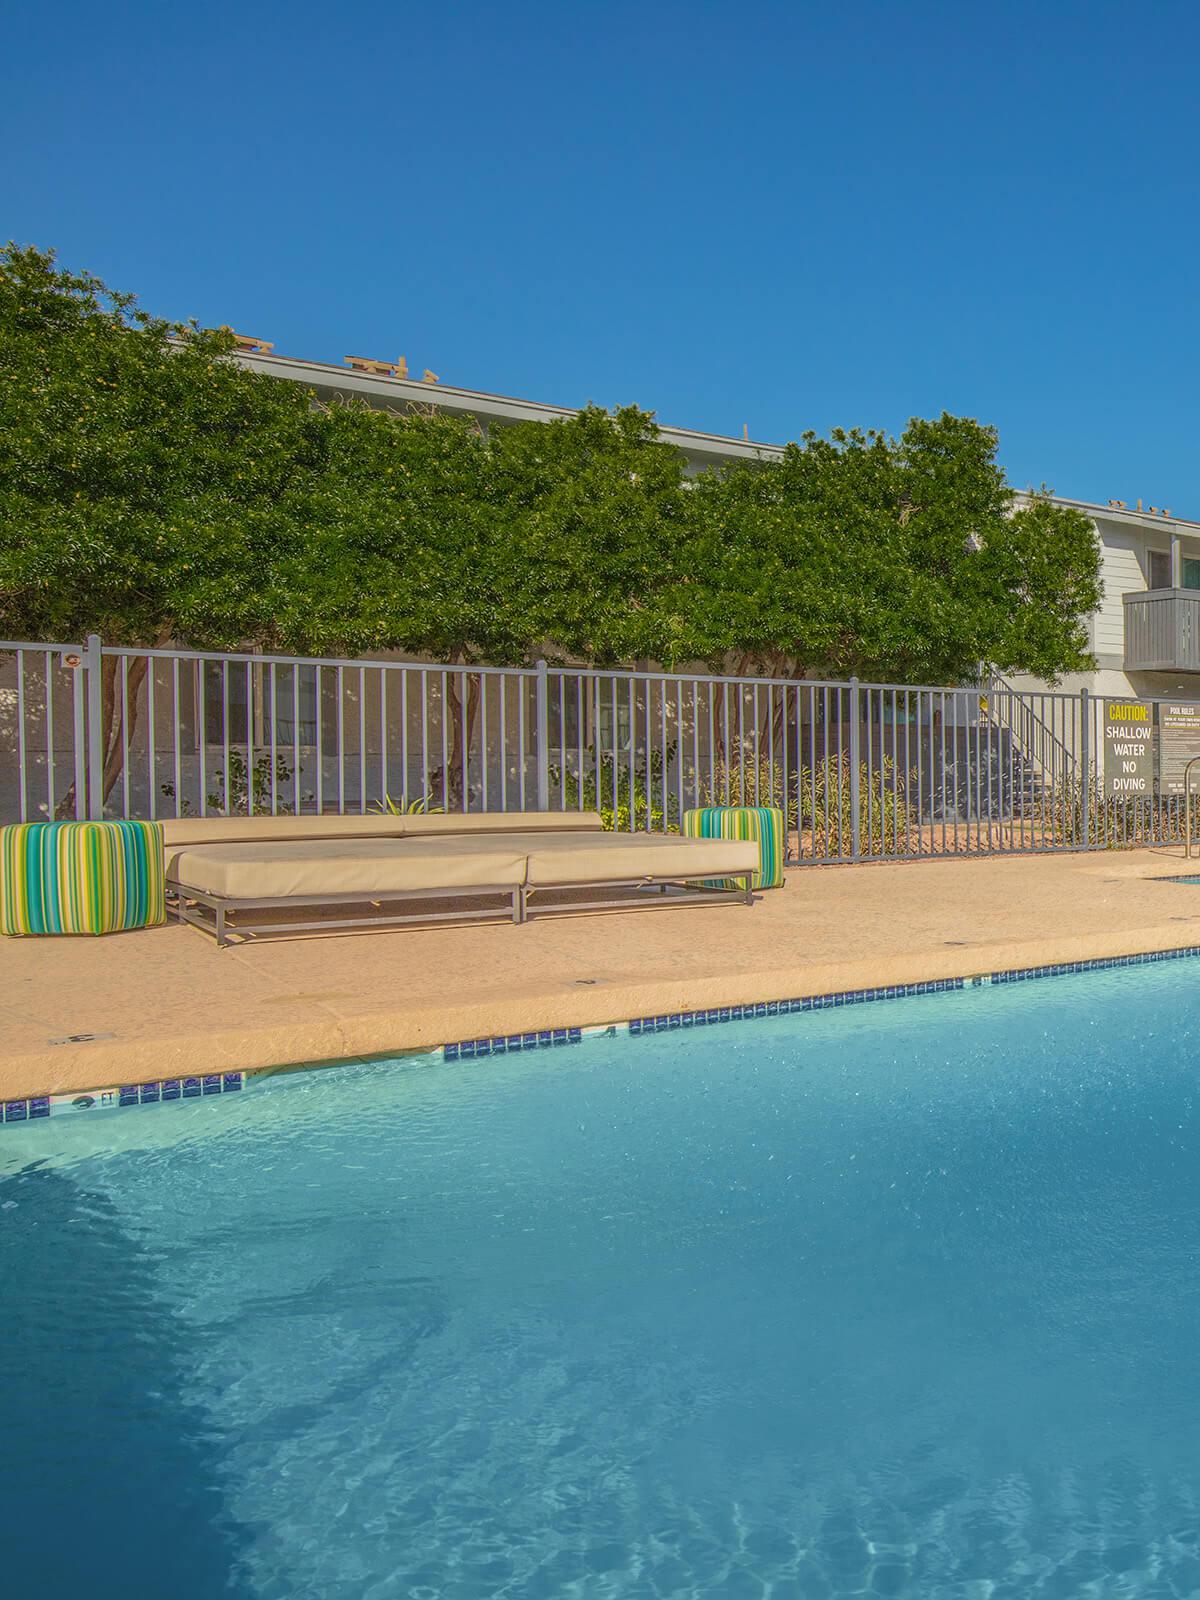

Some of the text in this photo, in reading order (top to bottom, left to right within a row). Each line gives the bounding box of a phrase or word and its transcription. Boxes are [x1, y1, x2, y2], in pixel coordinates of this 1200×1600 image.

[1109, 704, 1149, 721] CAUTION:
[1170, 706, 1181, 715] POOL
[1106, 726, 1151, 740] SHALLOW
[1113, 743, 1145, 757] WATER
[1122, 760, 1137, 773] NO
[1113, 777, 1146, 790] DIVING
